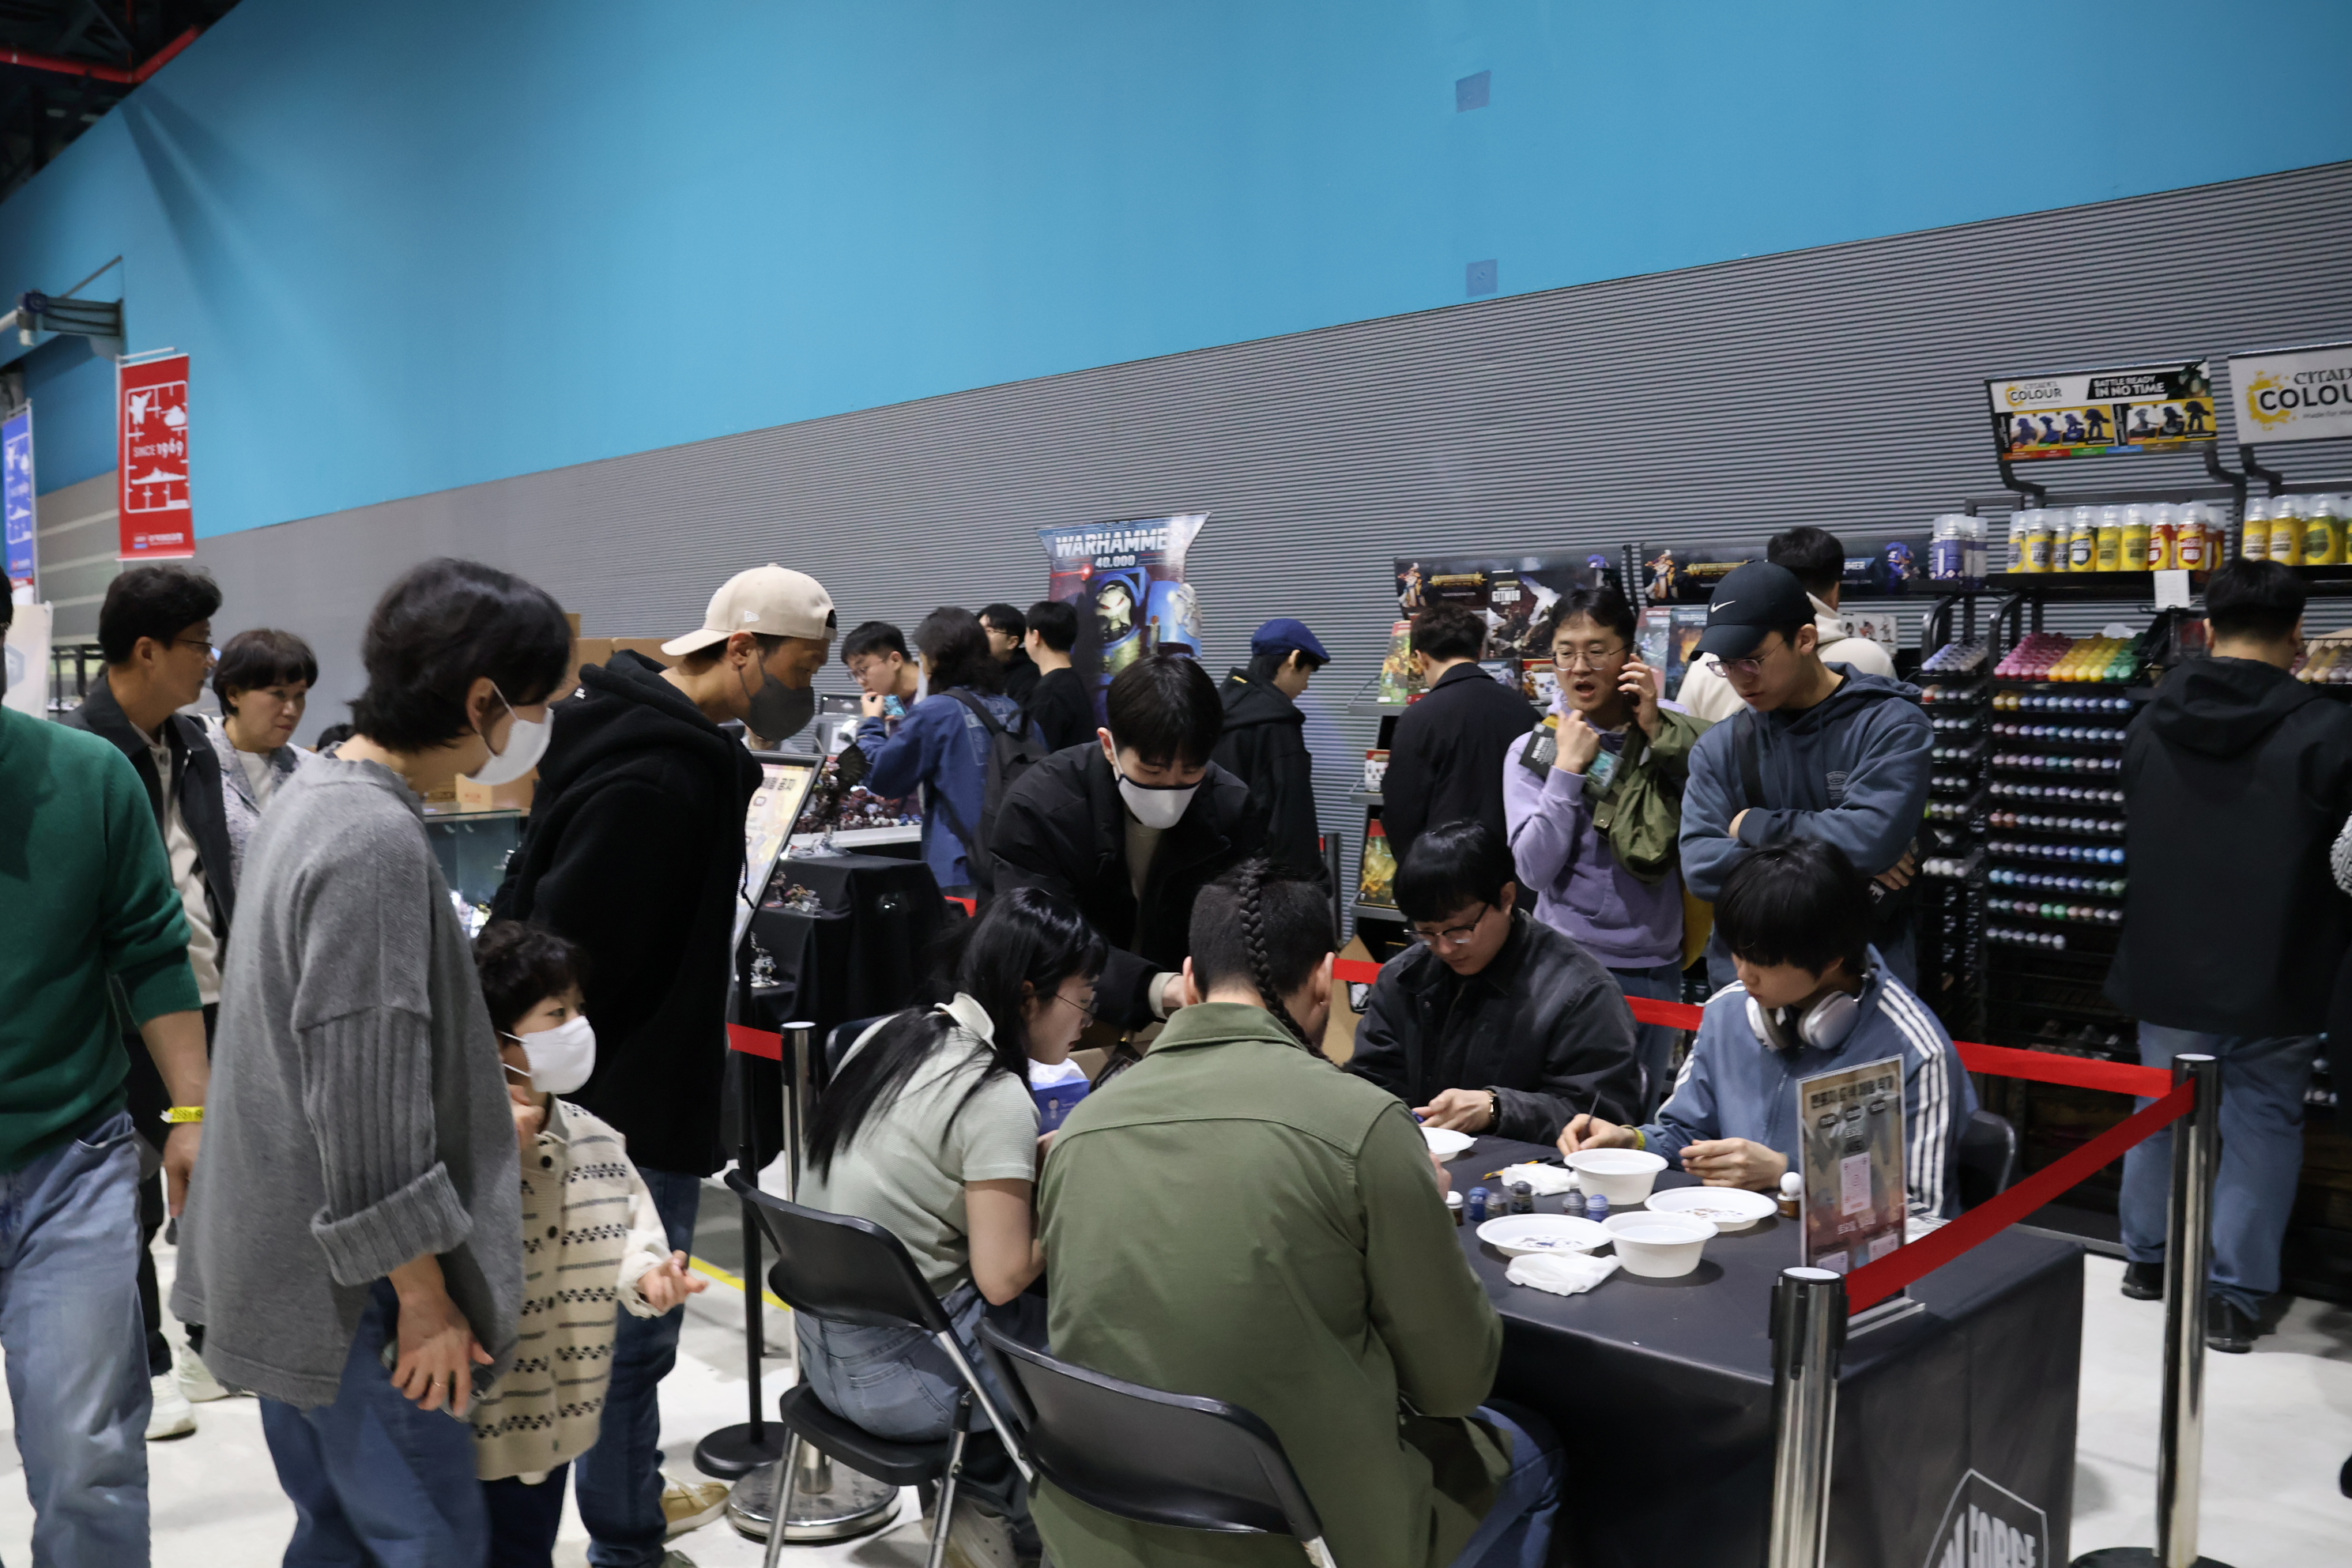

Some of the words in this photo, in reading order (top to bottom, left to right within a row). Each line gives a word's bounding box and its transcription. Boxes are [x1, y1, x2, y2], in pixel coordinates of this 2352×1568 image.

[2094, 378, 2127, 388] BATTLE
[2128, 375, 2156, 385] READY
[2010, 388, 2062, 401] COLOUR
[2094, 387, 2109, 398] IN
[2111, 385, 2132, 397] NO
[2133, 383, 2165, 394] TIME
[133, 446, 156, 458] SINCE
[156, 438, 184, 458] 1969
[1055, 528, 1179, 558] WARHAMME
